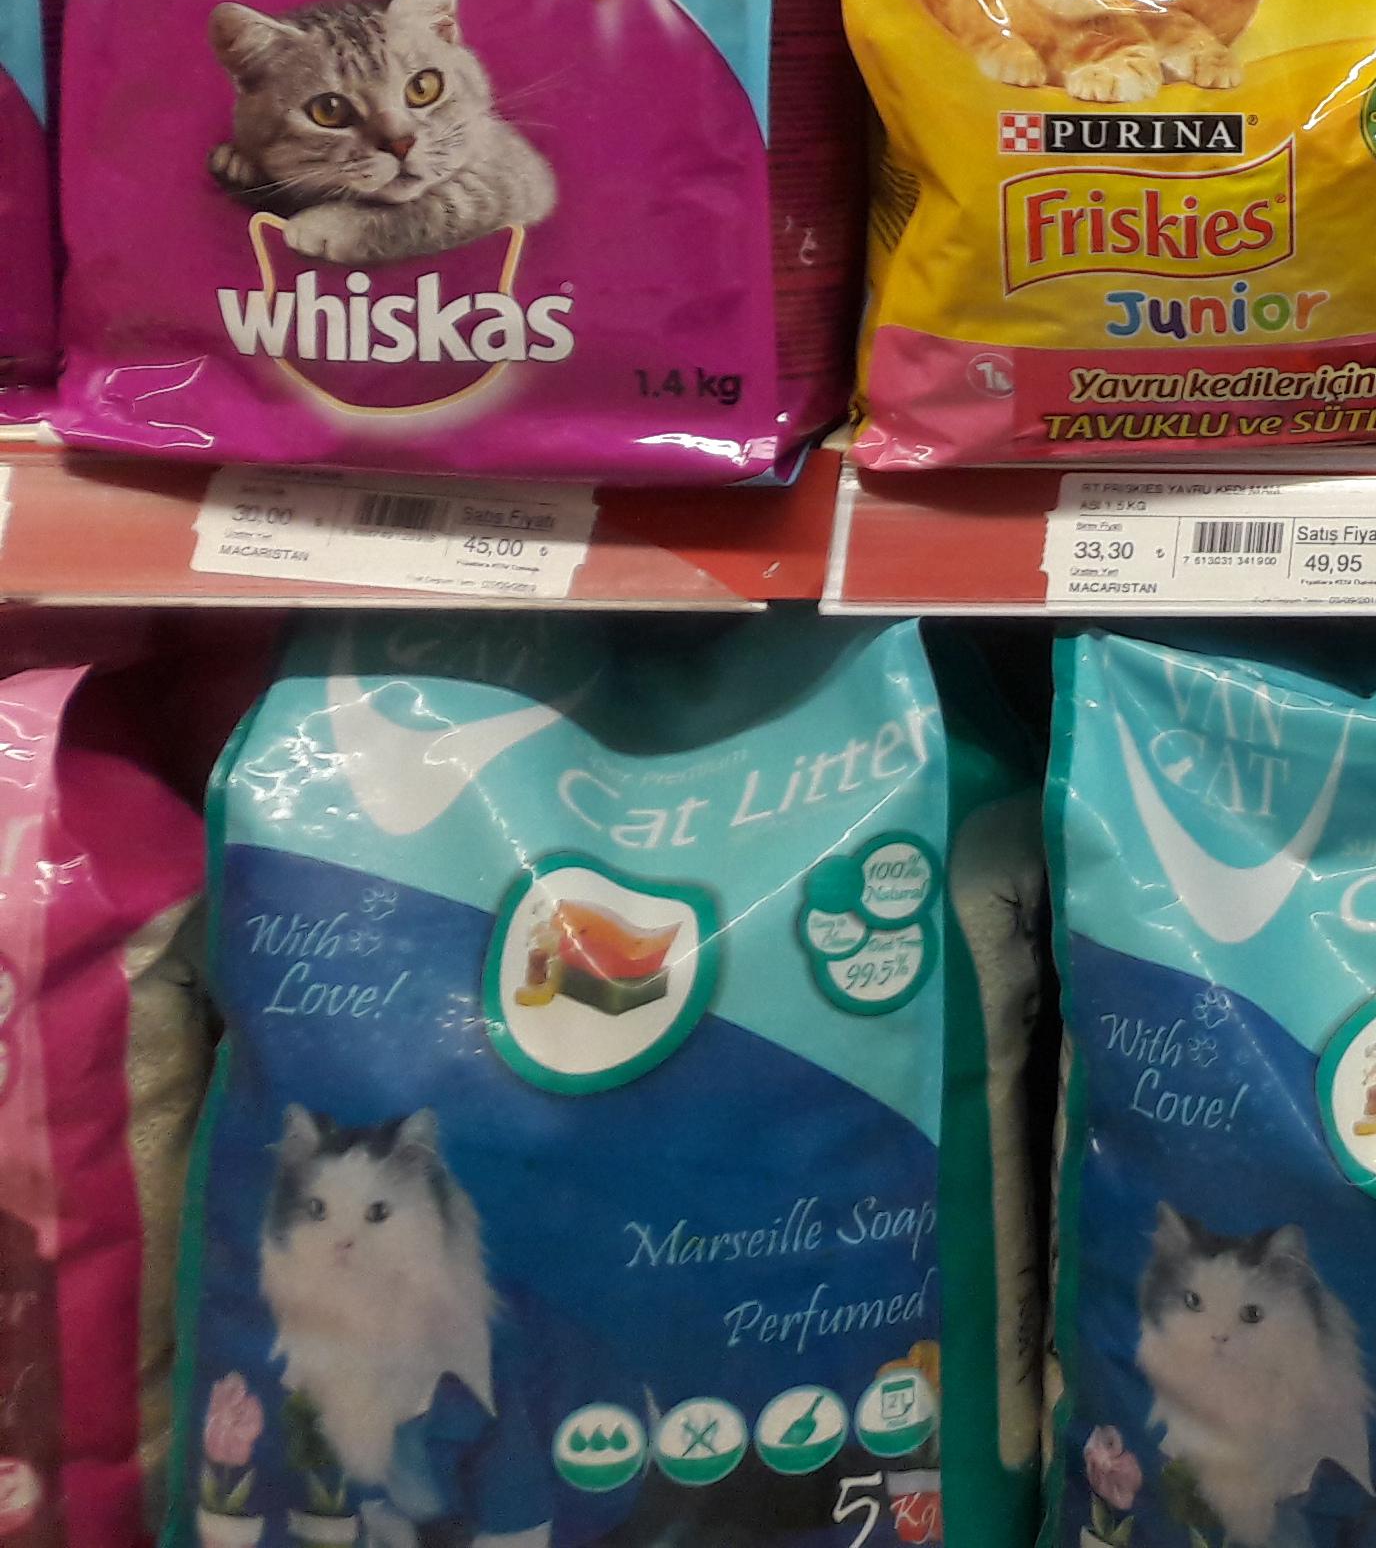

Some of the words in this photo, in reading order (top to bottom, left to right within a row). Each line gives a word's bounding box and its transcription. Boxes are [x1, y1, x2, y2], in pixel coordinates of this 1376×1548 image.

[1051, 118, 1237, 151] PURINA
[1025, 186, 1275, 264] Friskies
[217, 270, 575, 363] whiskas
[1106, 282, 1329, 340] Junior
[633, 368, 684, 400] 1.4
[694, 368, 743, 405] kg
[1070, 368, 1184, 402] Yavru
[1189, 370, 1312, 401] kediler
[1044, 411, 1229, 442] TAVUKLU
[1240, 411, 1282, 437] ve
[463, 535, 524, 558] 45,00
[1074, 541, 1135, 561] 33,30
[1297, 526, 1337, 545] Satış
[1068, 582, 1158, 594] MACARISTAN
[1304, 555, 1363, 574] 49,95
[557, 768, 711, 849] Cat
[730, 706, 940, 827] Litter
[246, 911, 342, 963] With
[264, 963, 407, 1021] Love!
[1100, 1011, 1184, 1066] With
[1130, 1068, 1251, 1133] Love!
[624, 1196, 823, 1268] Marseille
[836, 1196, 937, 1261] Soap
[724, 1267, 939, 1354] Perfumed
